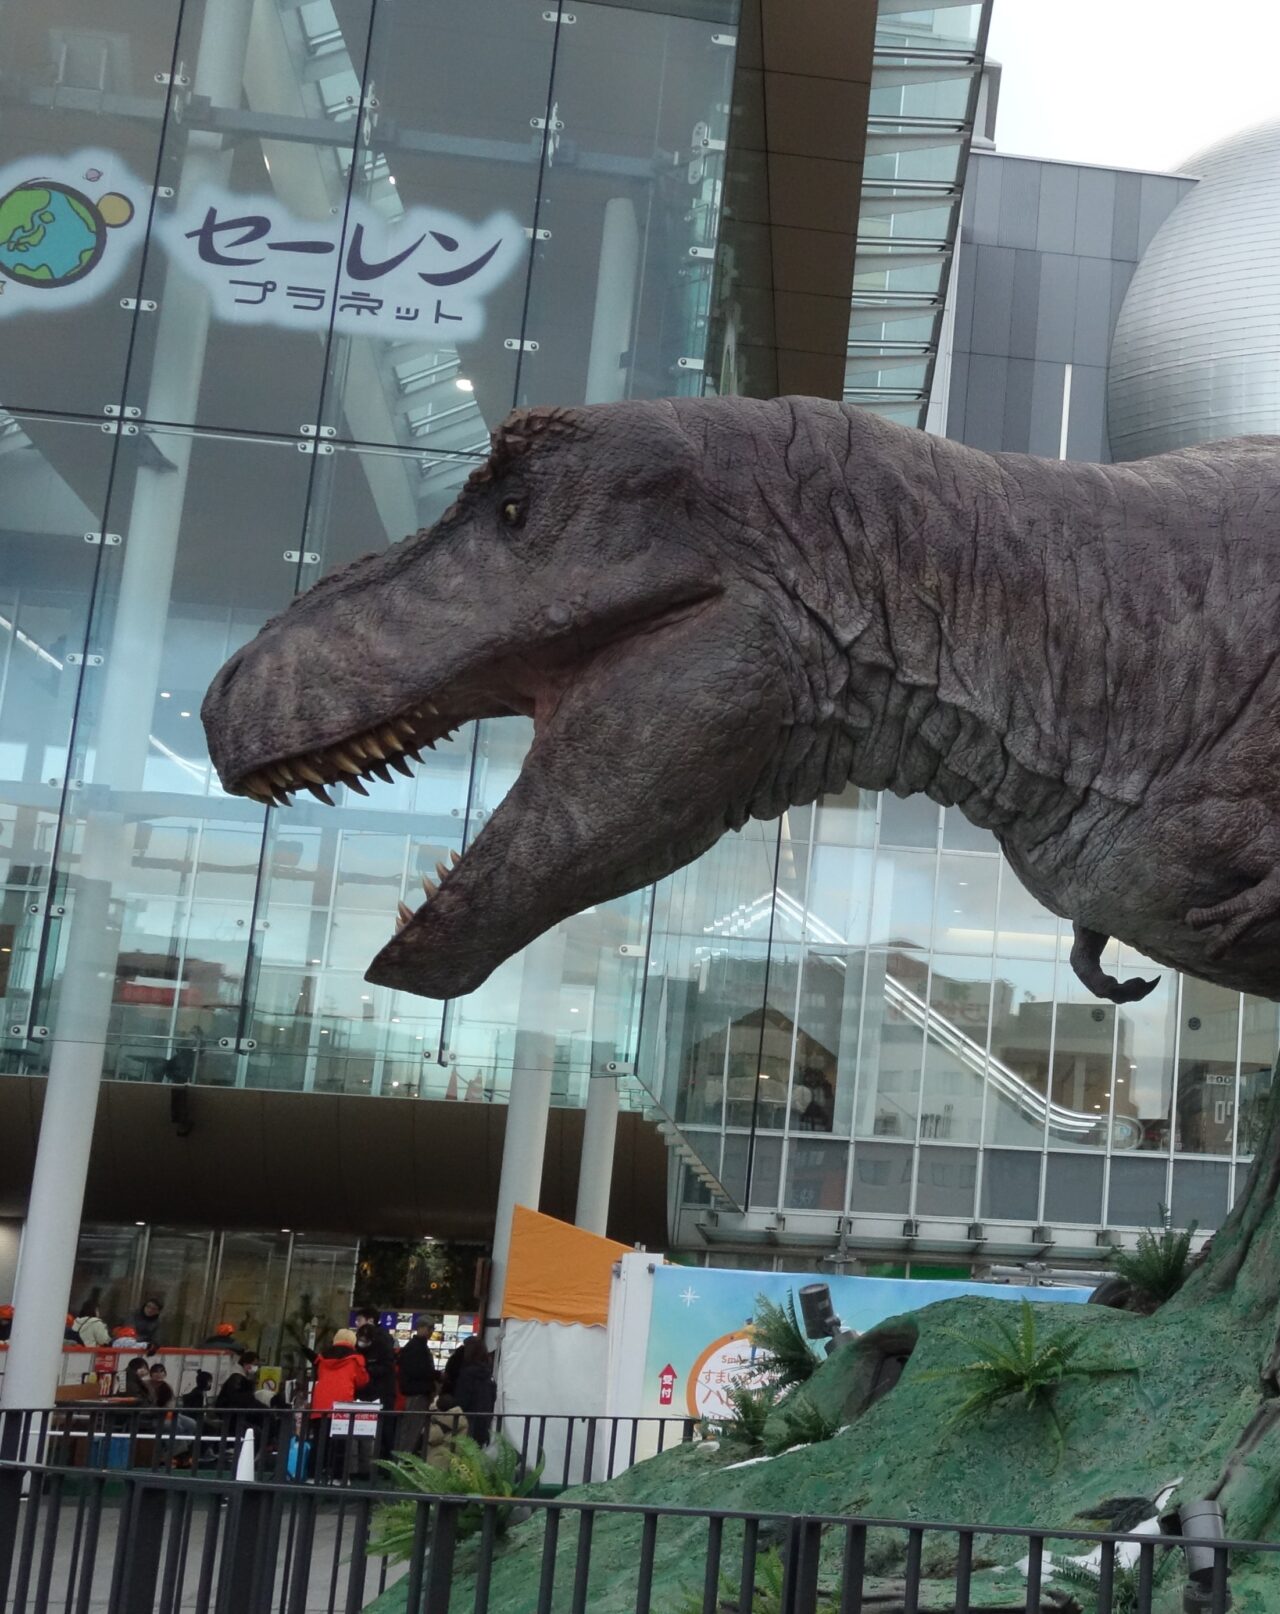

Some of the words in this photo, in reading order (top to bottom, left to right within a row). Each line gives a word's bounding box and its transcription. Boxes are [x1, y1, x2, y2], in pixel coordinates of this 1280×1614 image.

[184, 206, 503, 287] セーレン
[229, 279, 463, 324] プラネット
